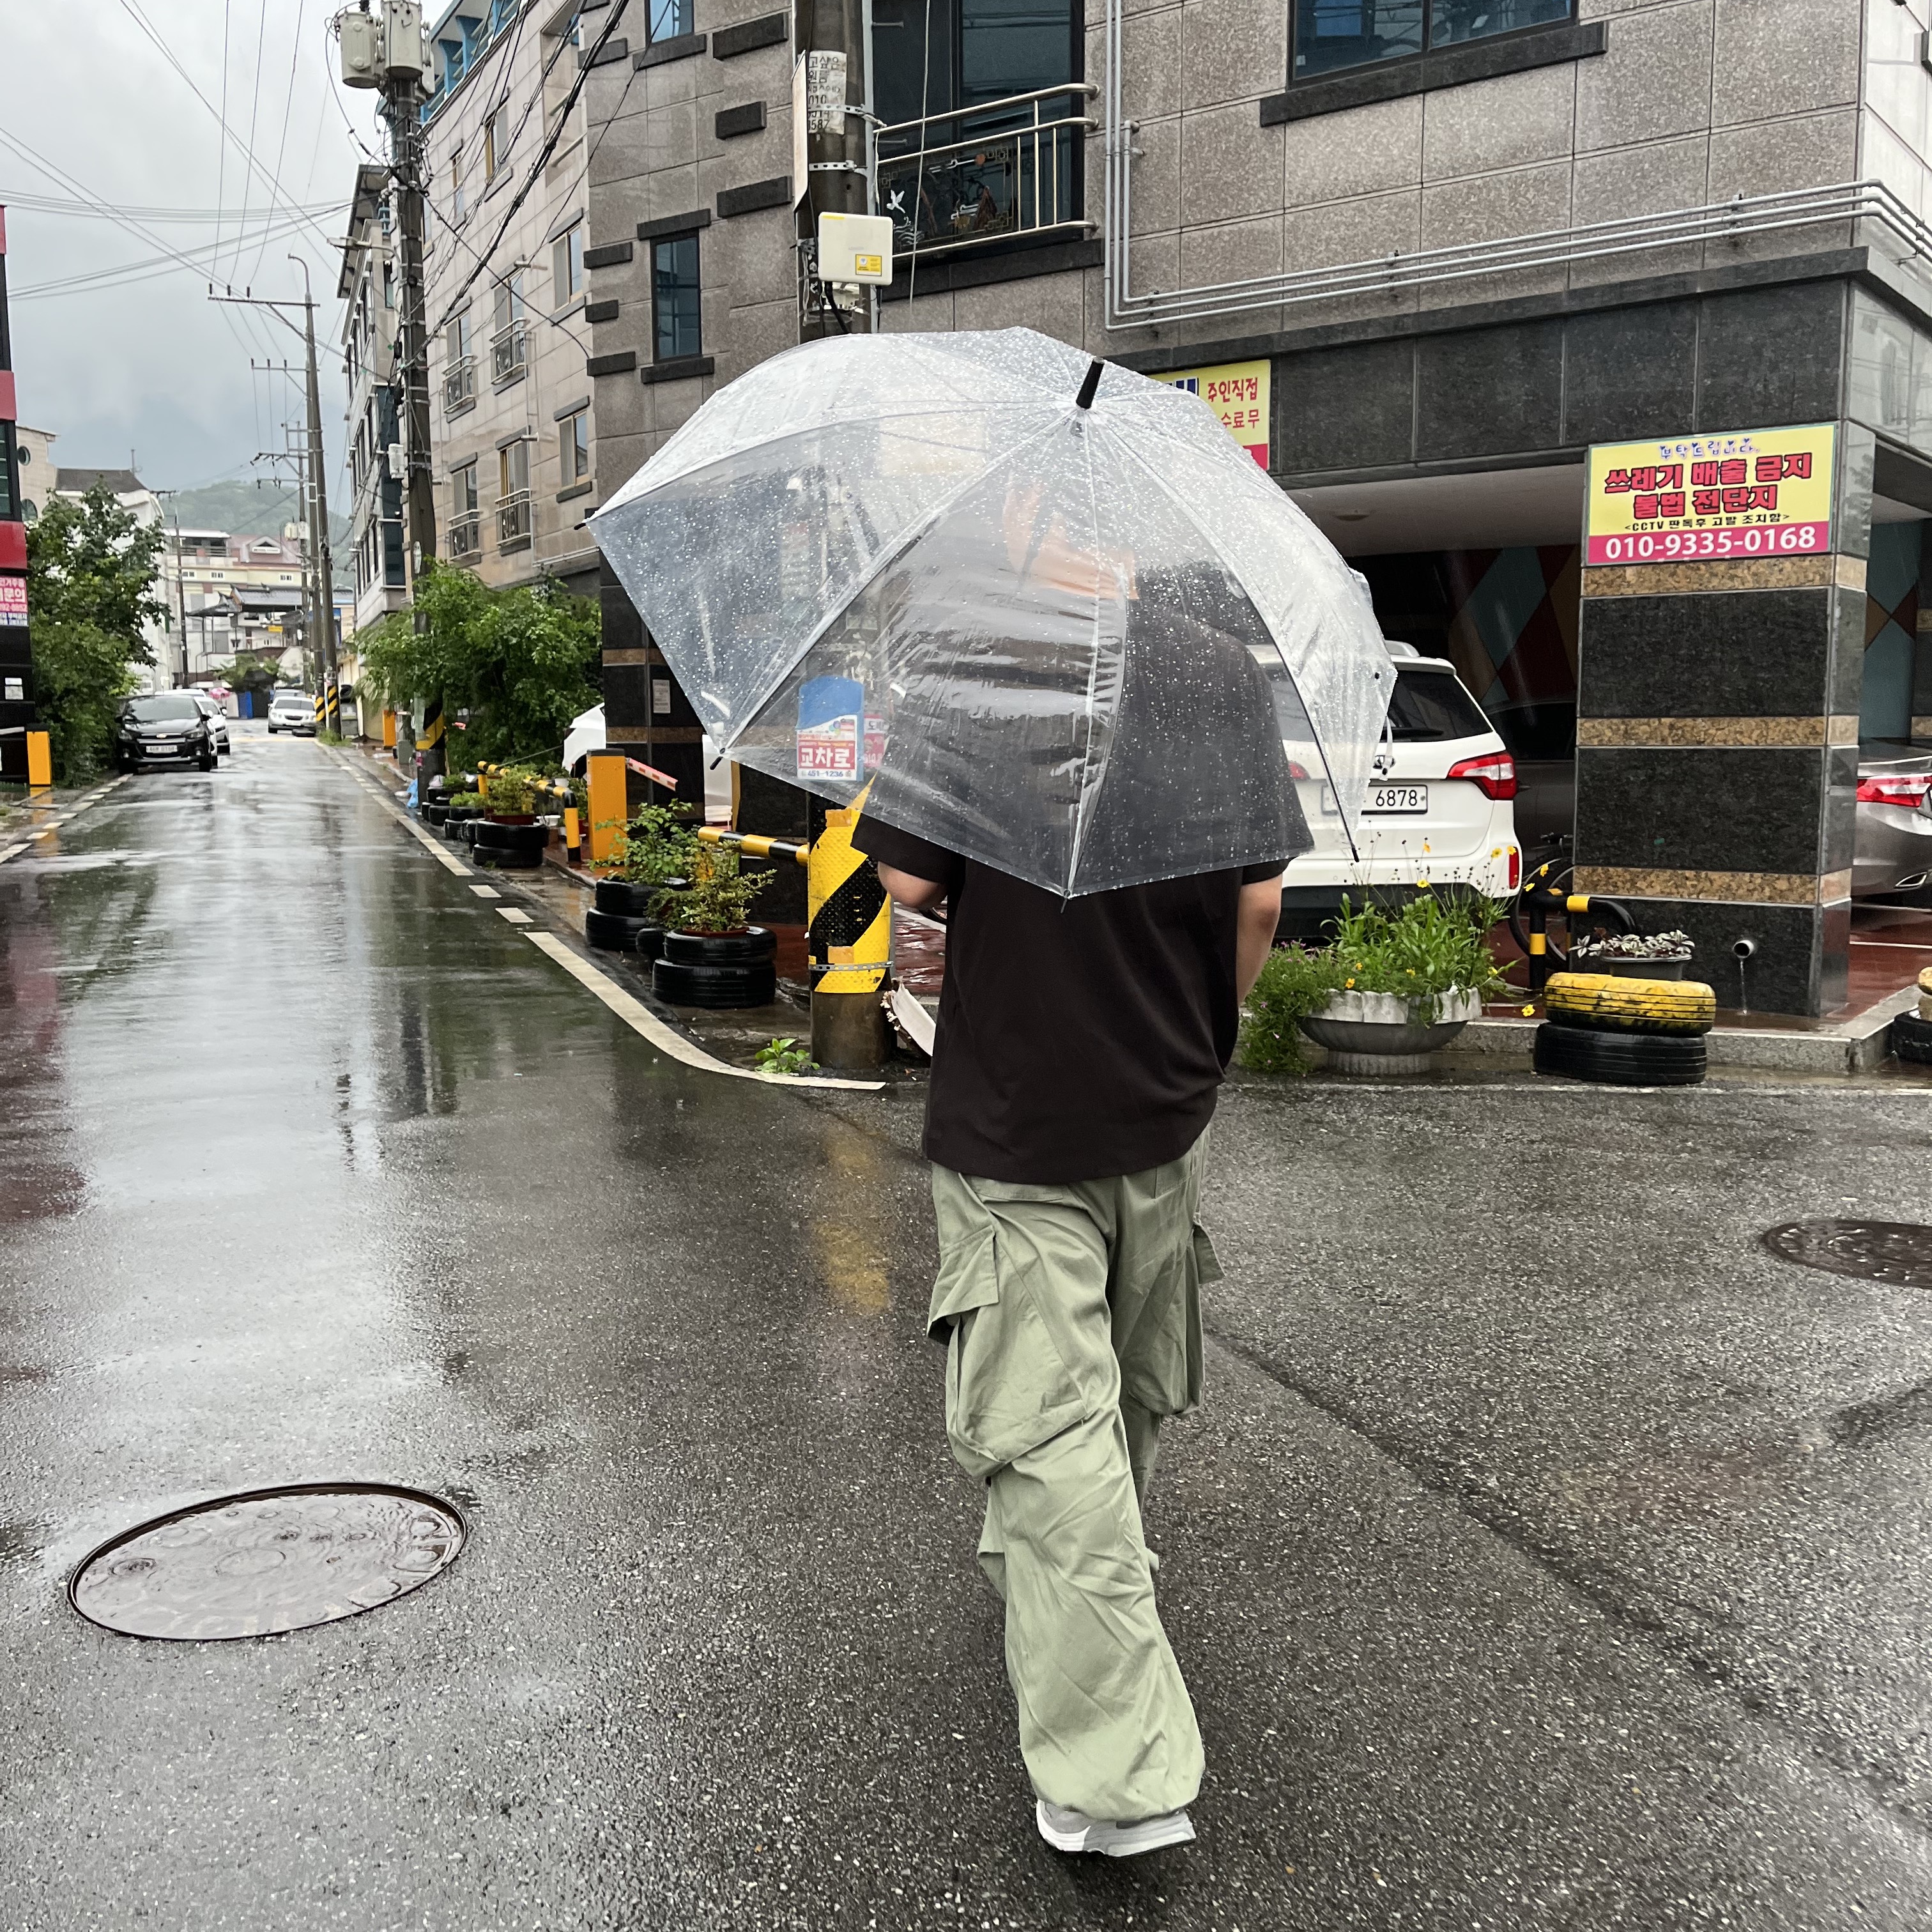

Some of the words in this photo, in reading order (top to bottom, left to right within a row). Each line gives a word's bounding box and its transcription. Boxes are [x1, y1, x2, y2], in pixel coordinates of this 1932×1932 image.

[808, 94, 827, 104] 010
[1208, 377, 1258, 403] 주인직접
[1604, 464, 1683, 494] 쓰레기
[1690, 459, 1748, 486] 배출
[1755, 452, 1813, 482] 금지
[1634, 491, 1686, 520] 불법
[1692, 484, 1778, 515] 전단지
[1712, 516, 1736, 526] 고발
[1605, 525, 1816, 560] 010-9335-0168
[801, 746, 851, 768] 교차로
[1376, 789, 1418, 807] 6878
